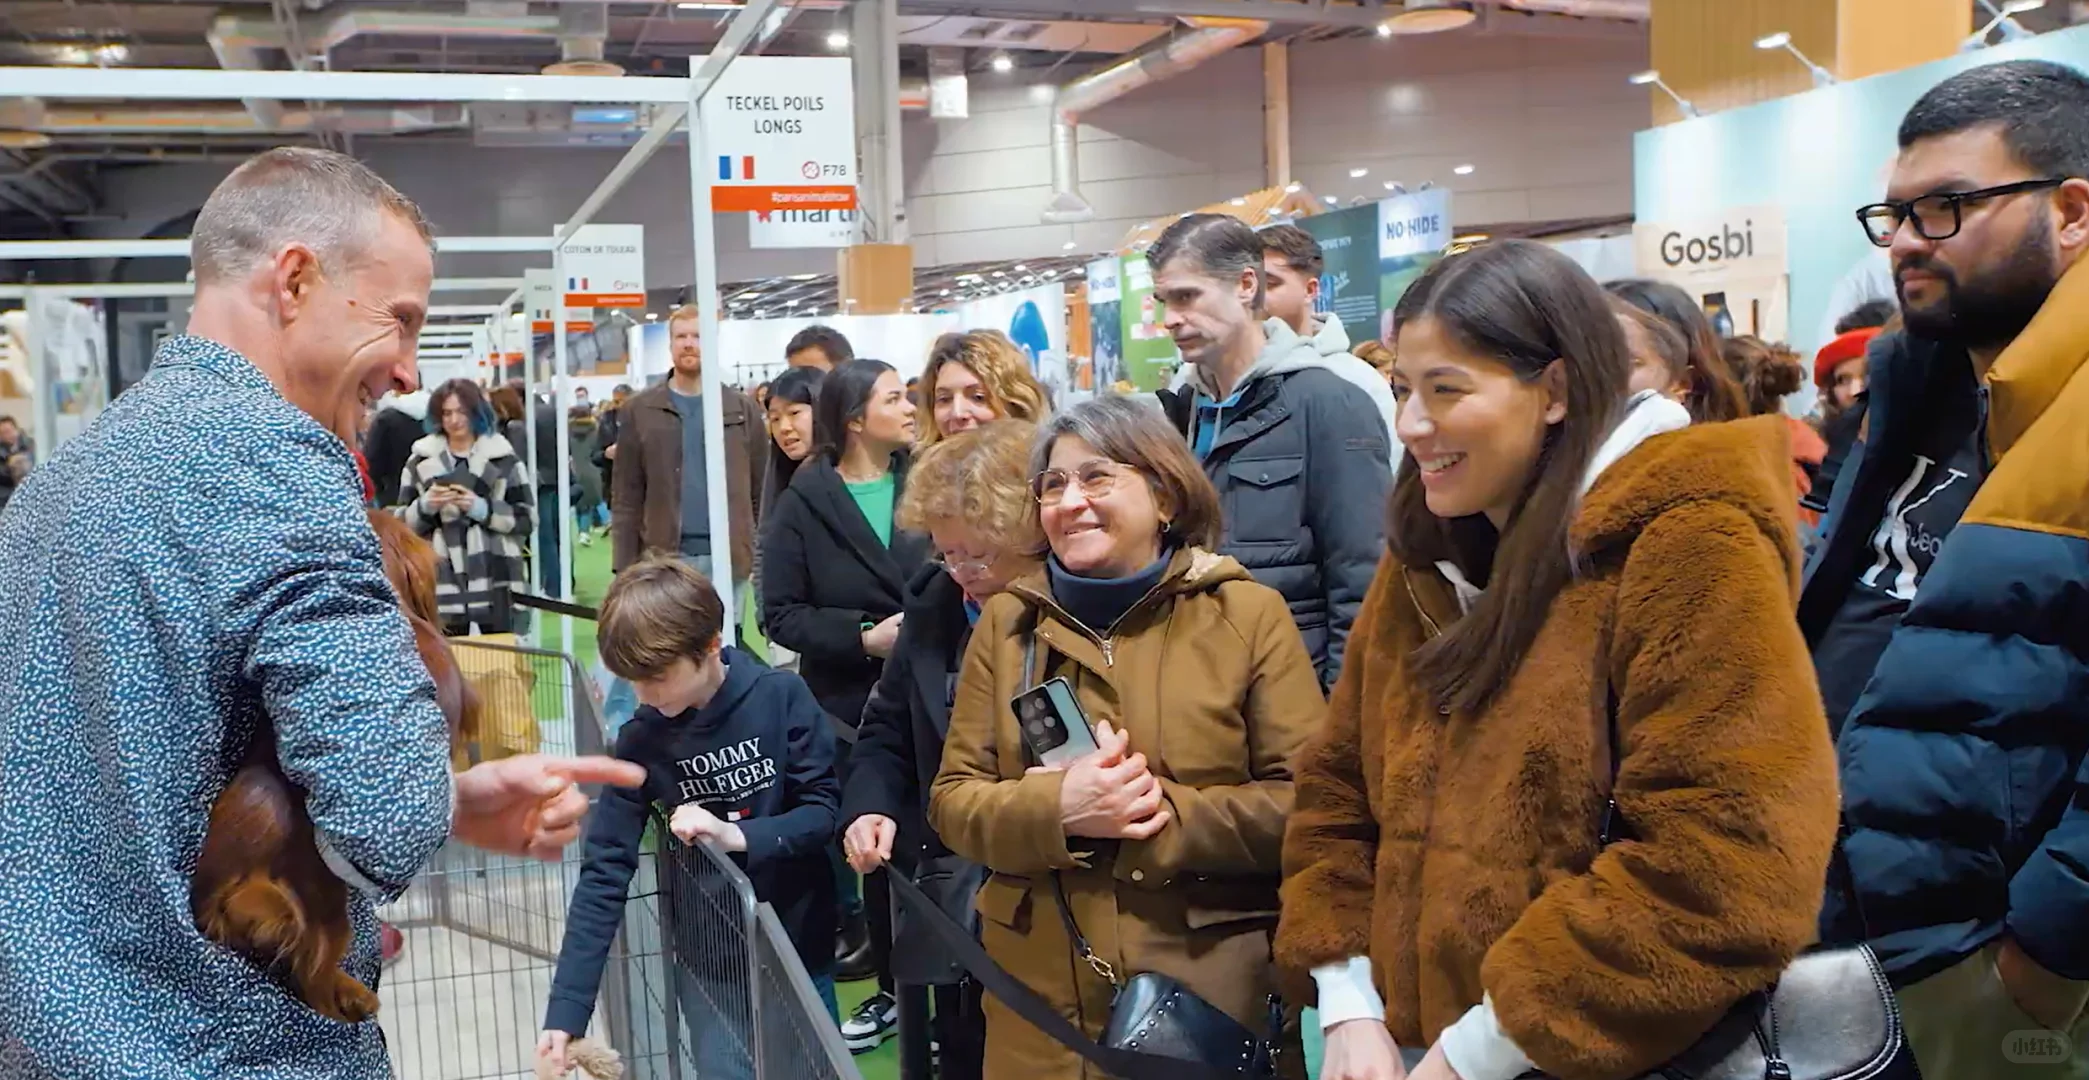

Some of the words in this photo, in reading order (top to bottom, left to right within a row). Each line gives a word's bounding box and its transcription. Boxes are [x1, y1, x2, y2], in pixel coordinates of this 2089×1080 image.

[726, 96, 779, 111] TECKEL
[783, 96, 824, 111] POILS
[754, 119, 803, 134] LONGS
[822, 164, 847, 176] F78
[1660, 218, 1753, 266] Gosbi
[677, 738, 762, 776] TOMMY
[678, 758, 776, 799] HILFIGER
